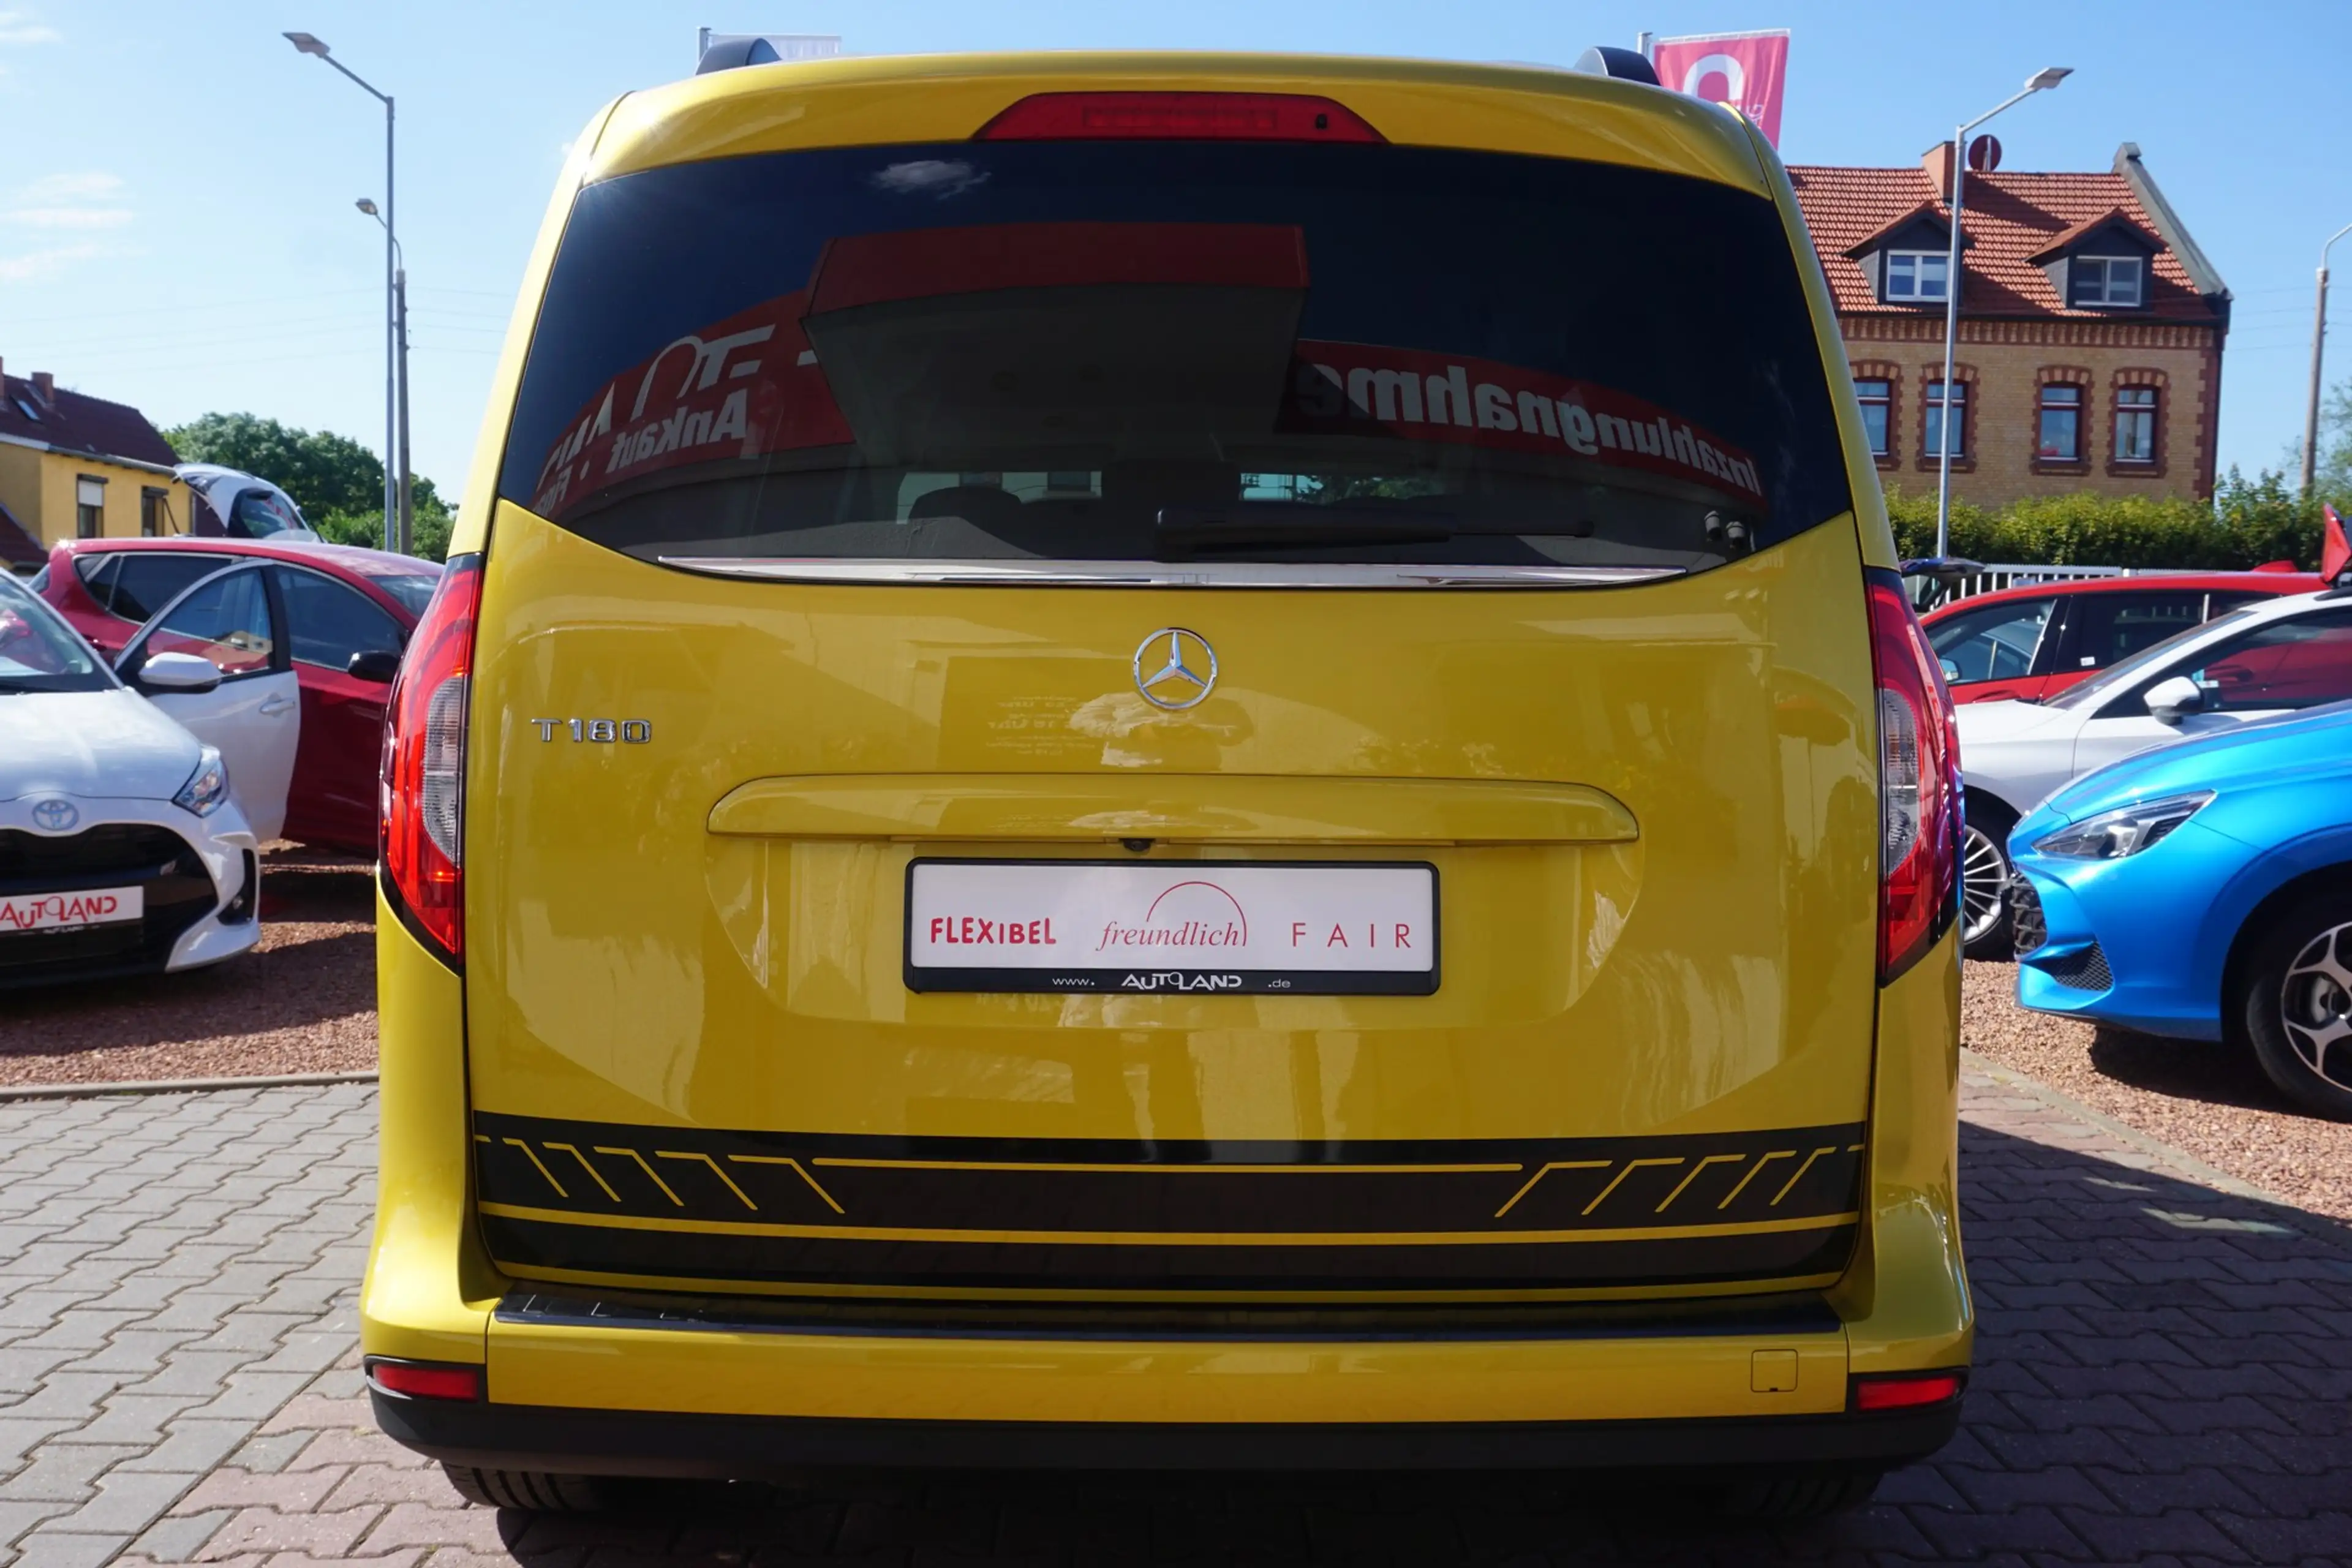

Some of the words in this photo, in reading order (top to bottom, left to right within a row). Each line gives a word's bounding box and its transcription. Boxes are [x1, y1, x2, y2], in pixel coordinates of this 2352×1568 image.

[531, 718, 652, 744] T180
[0, 895, 118, 930] AUTOLAND
[930, 916, 1057, 944] FLEXIBEL
[1095, 921, 1238, 951] freundlich
[1292, 922, 1411, 948] FAIR
[1121, 971, 1242, 990] AUTOLAND
[1267, 979, 1291, 988] .de
